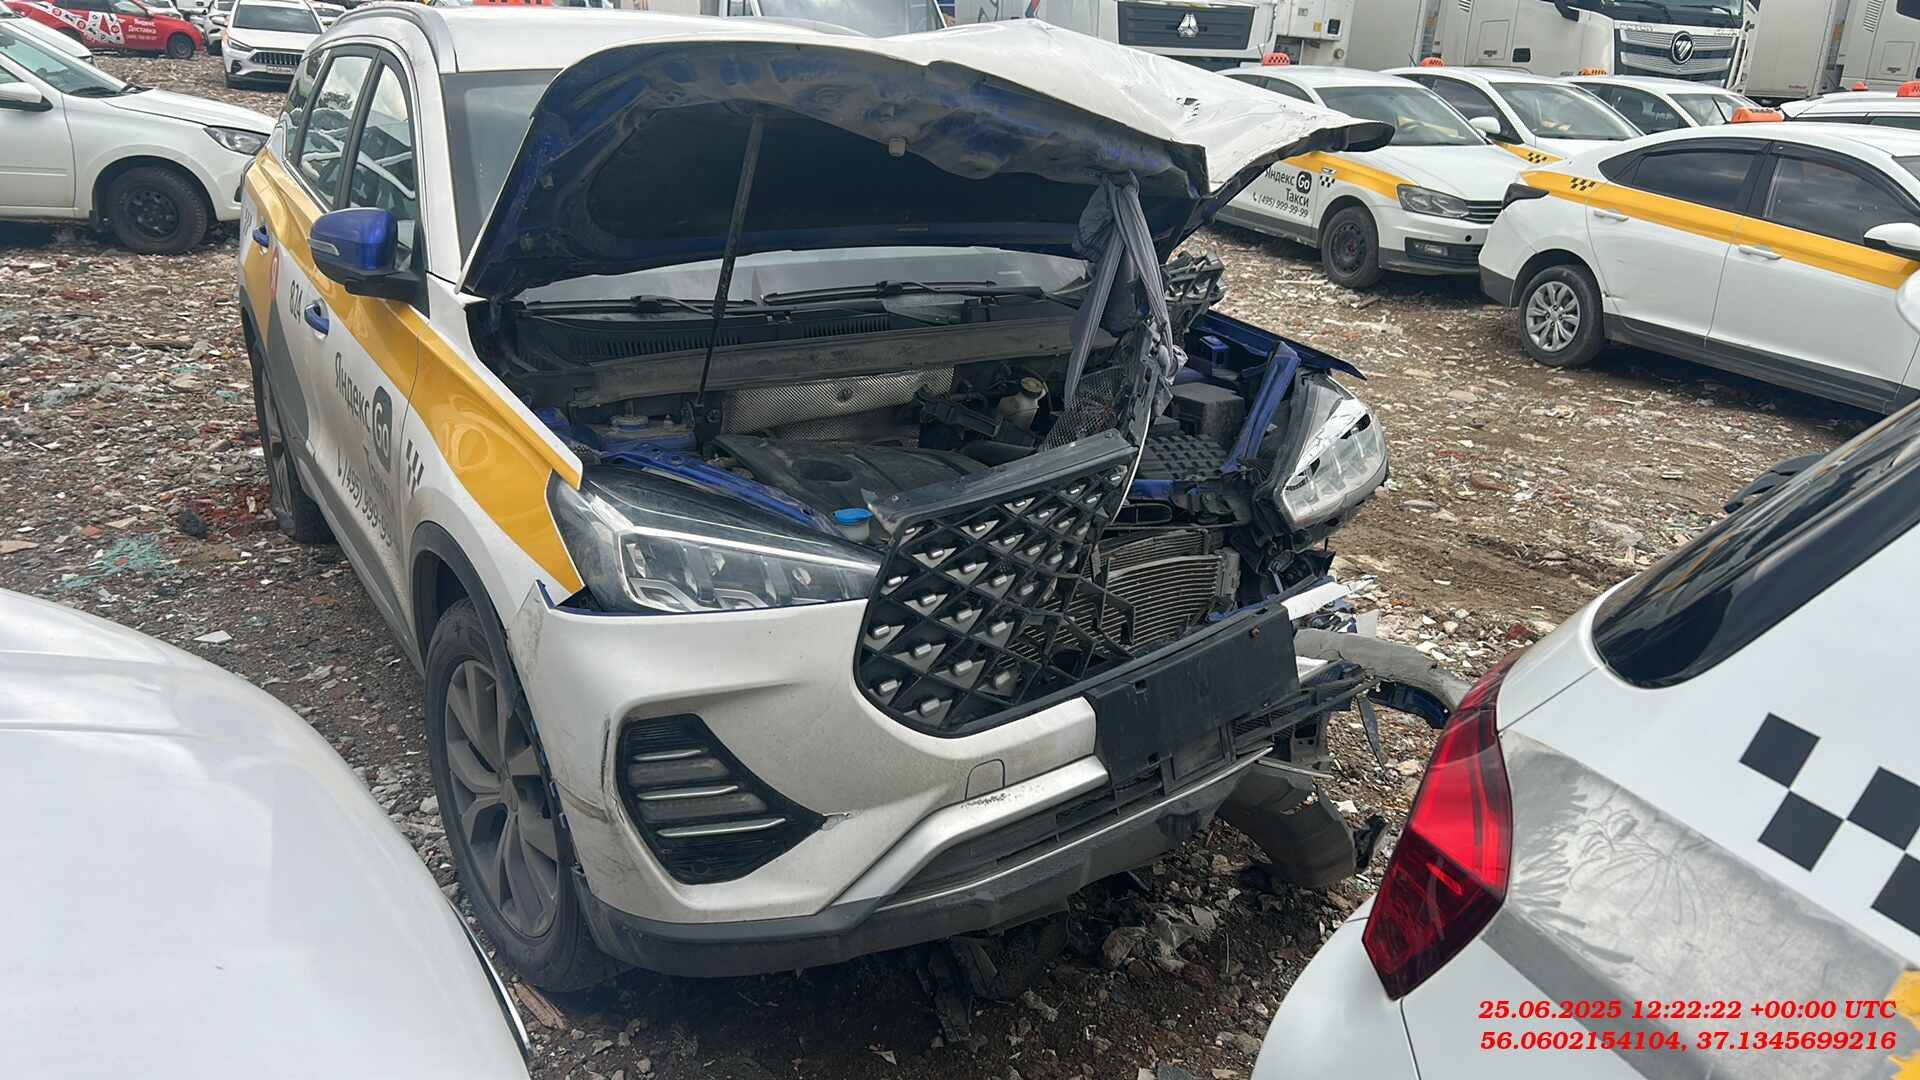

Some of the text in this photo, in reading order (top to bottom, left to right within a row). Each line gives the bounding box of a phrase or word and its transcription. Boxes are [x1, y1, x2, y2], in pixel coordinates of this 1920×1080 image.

[1265, 167, 1295, 186] Яндекс
[1258, 193, 1309, 217] (495) 999-99-99
[1286, 188, 1310, 207] Такси
[335, 351, 371, 433] Яндекс
[340, 456, 362, 508] (495)
